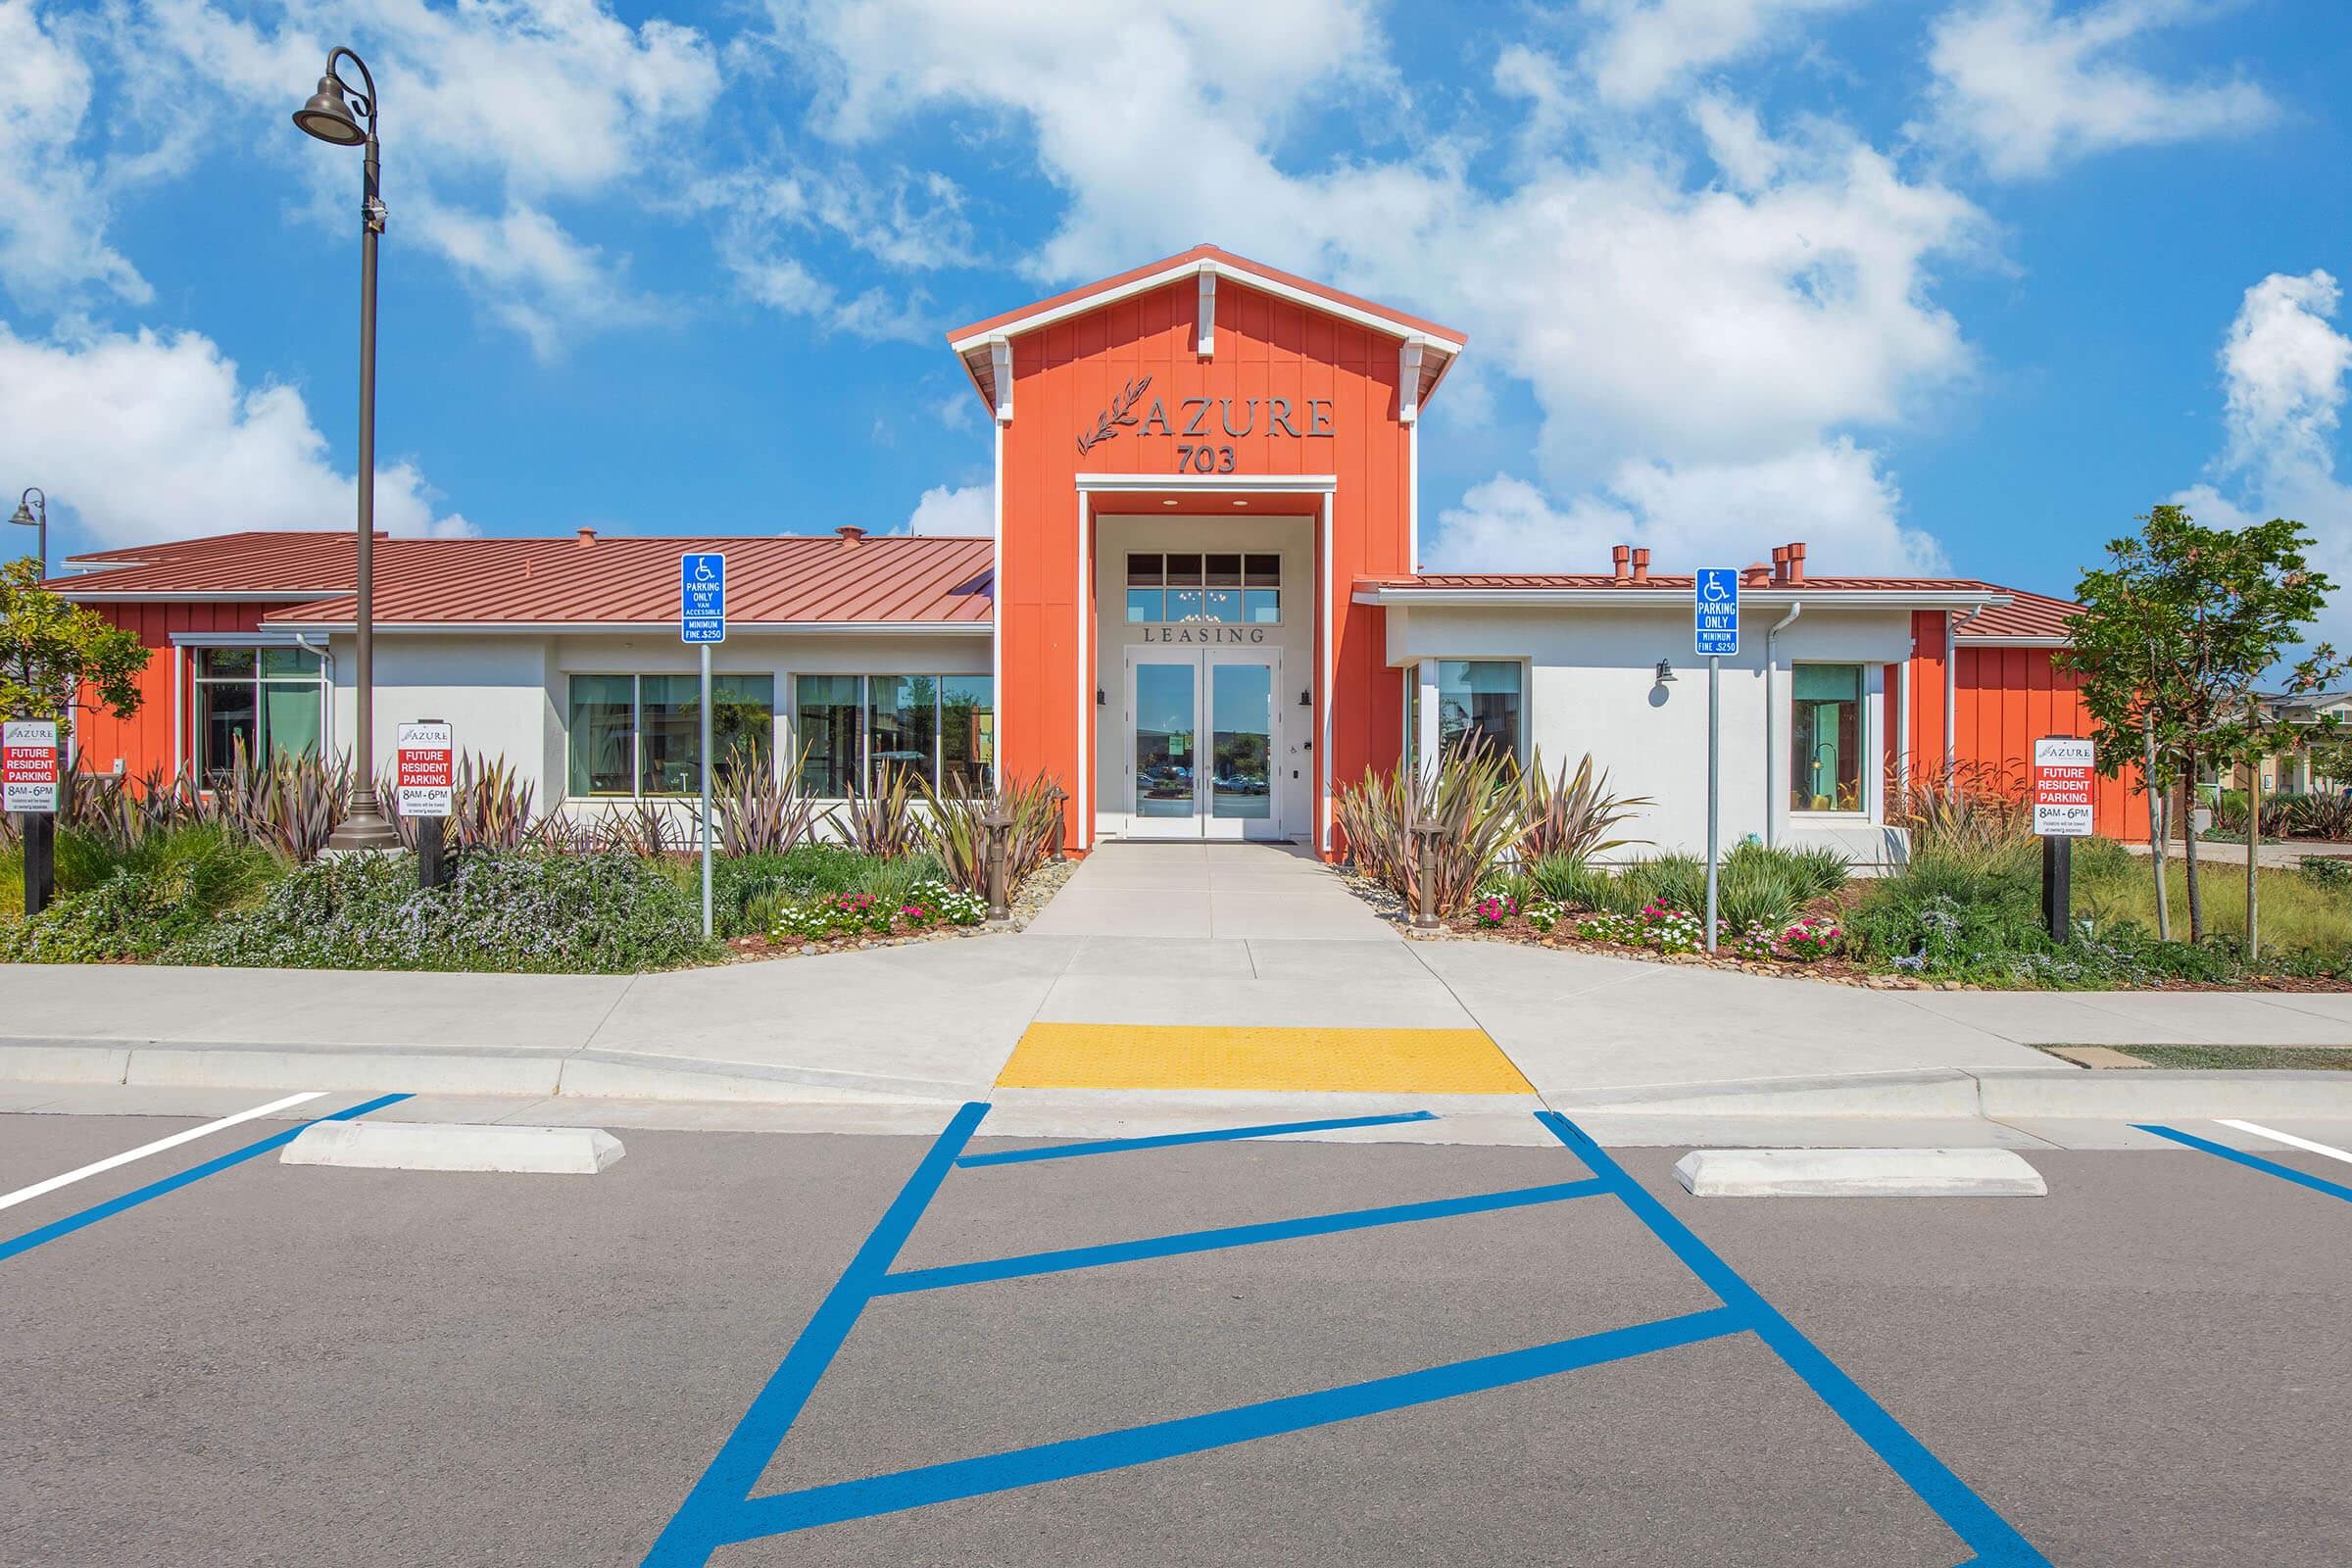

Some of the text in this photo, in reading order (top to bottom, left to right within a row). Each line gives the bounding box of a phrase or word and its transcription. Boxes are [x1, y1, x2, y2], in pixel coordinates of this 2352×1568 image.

[1137, 397, 1335, 437] AZURE
[1177, 445, 1235, 473] 703
[686, 582, 720, 592] PARKING
[693, 592, 713, 602] ONLY
[1698, 602, 1736, 614] PARKING
[689, 620, 718, 629] MINIMUM
[1705, 615, 1728, 628] ONLY
[685, 630, 700, 639] FINE
[1144, 627, 1264, 643] LEASING
[1702, 632, 1731, 641] MINIMUM
[1698, 642, 1736, 652] FINE $250
[11, 749, 49, 758] FUTURE
[406, 751, 444, 760] FUTURE
[2049, 749, 2091, 758] AZURE
[6, 760, 54, 769] RESIDENT
[401, 762, 448, 772] RESIDENT
[9, 772, 52, 781] PARKING
[2043, 768, 2085, 778] FUTURE
[403, 775, 446, 785] PARKING
[2037, 780, 2090, 791] RESIDENT
[8, 786, 27, 797] 8AM
[33, 786, 53, 797] 6PM
[403, 789, 422, 800] 8AM
[427, 790, 448, 801] 6PM
[2039, 793, 2087, 803] PARKING
[2039, 808, 2060, 819] 8AM
[2067, 808, 2088, 819] 6PM
